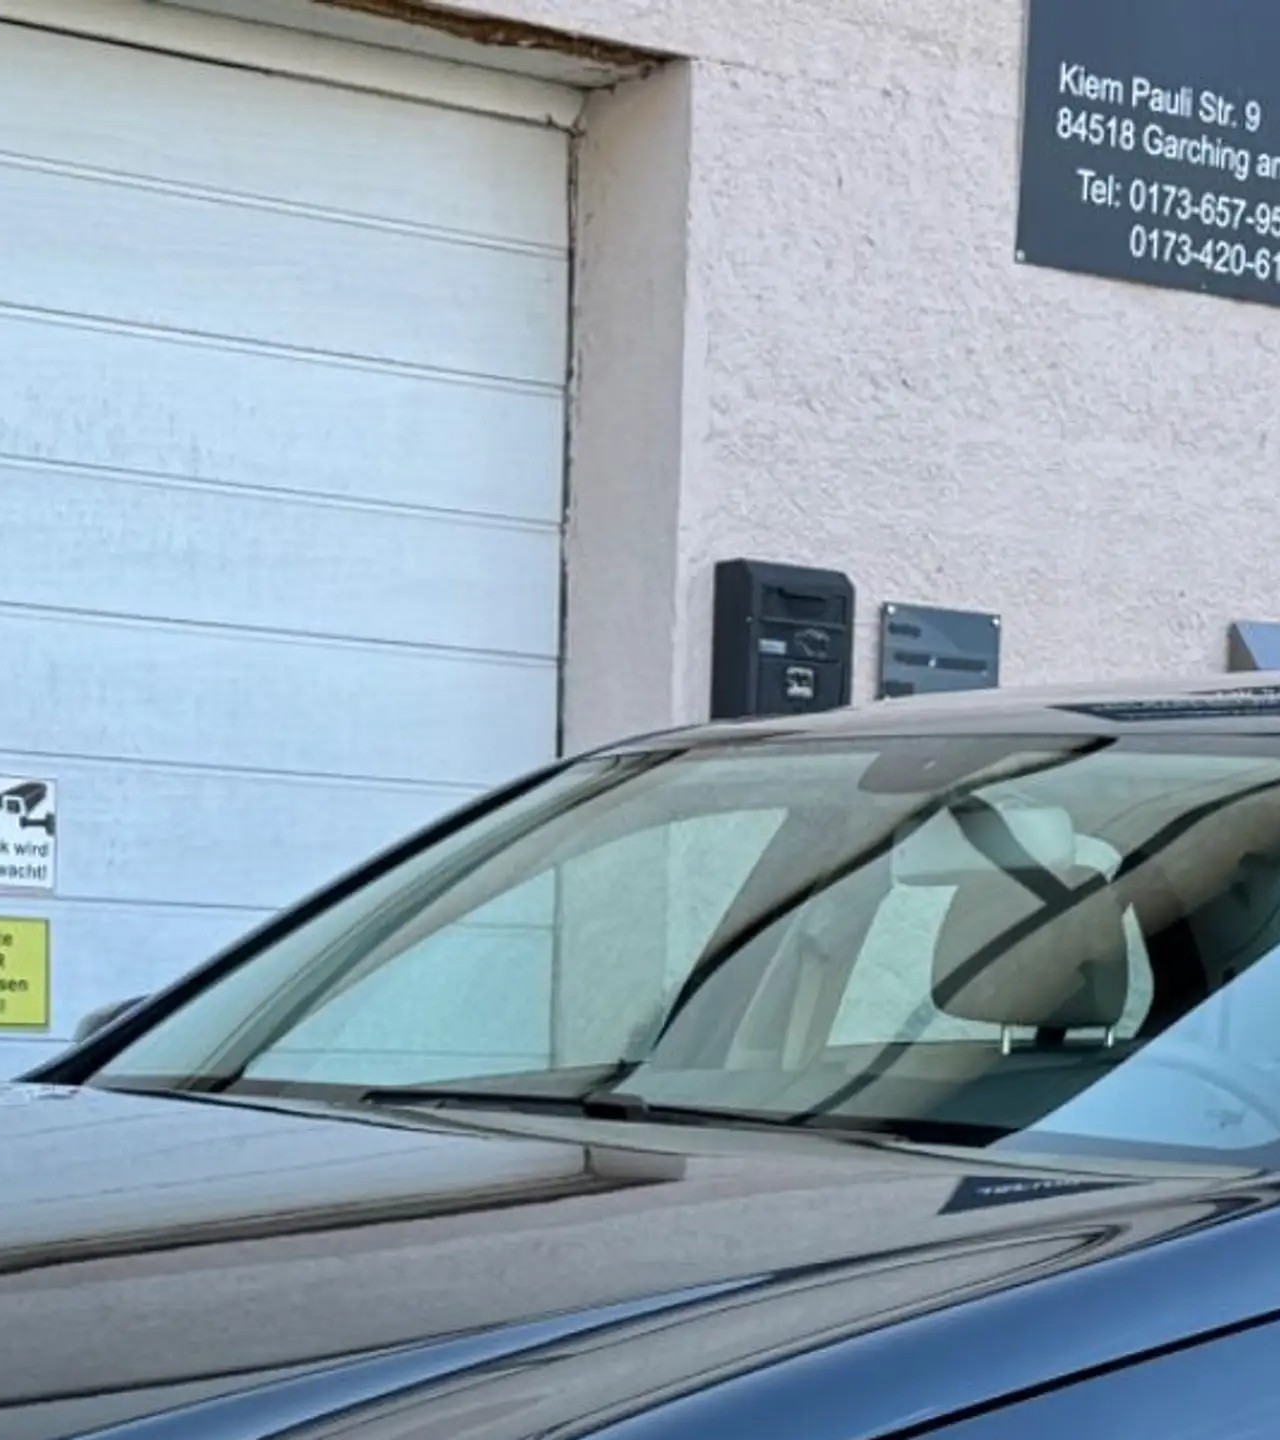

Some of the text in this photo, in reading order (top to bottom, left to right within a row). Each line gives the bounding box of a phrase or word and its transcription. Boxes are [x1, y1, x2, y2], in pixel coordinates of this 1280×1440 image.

[1059, 62, 1261, 132] Kiem Pauli Str. 9
[1056, 108, 1135, 150] 84518
[1143, 125, 1249, 182] Garching
[1076, 169, 1122, 208] Tel:
[13, 841, 49, 858] wird
